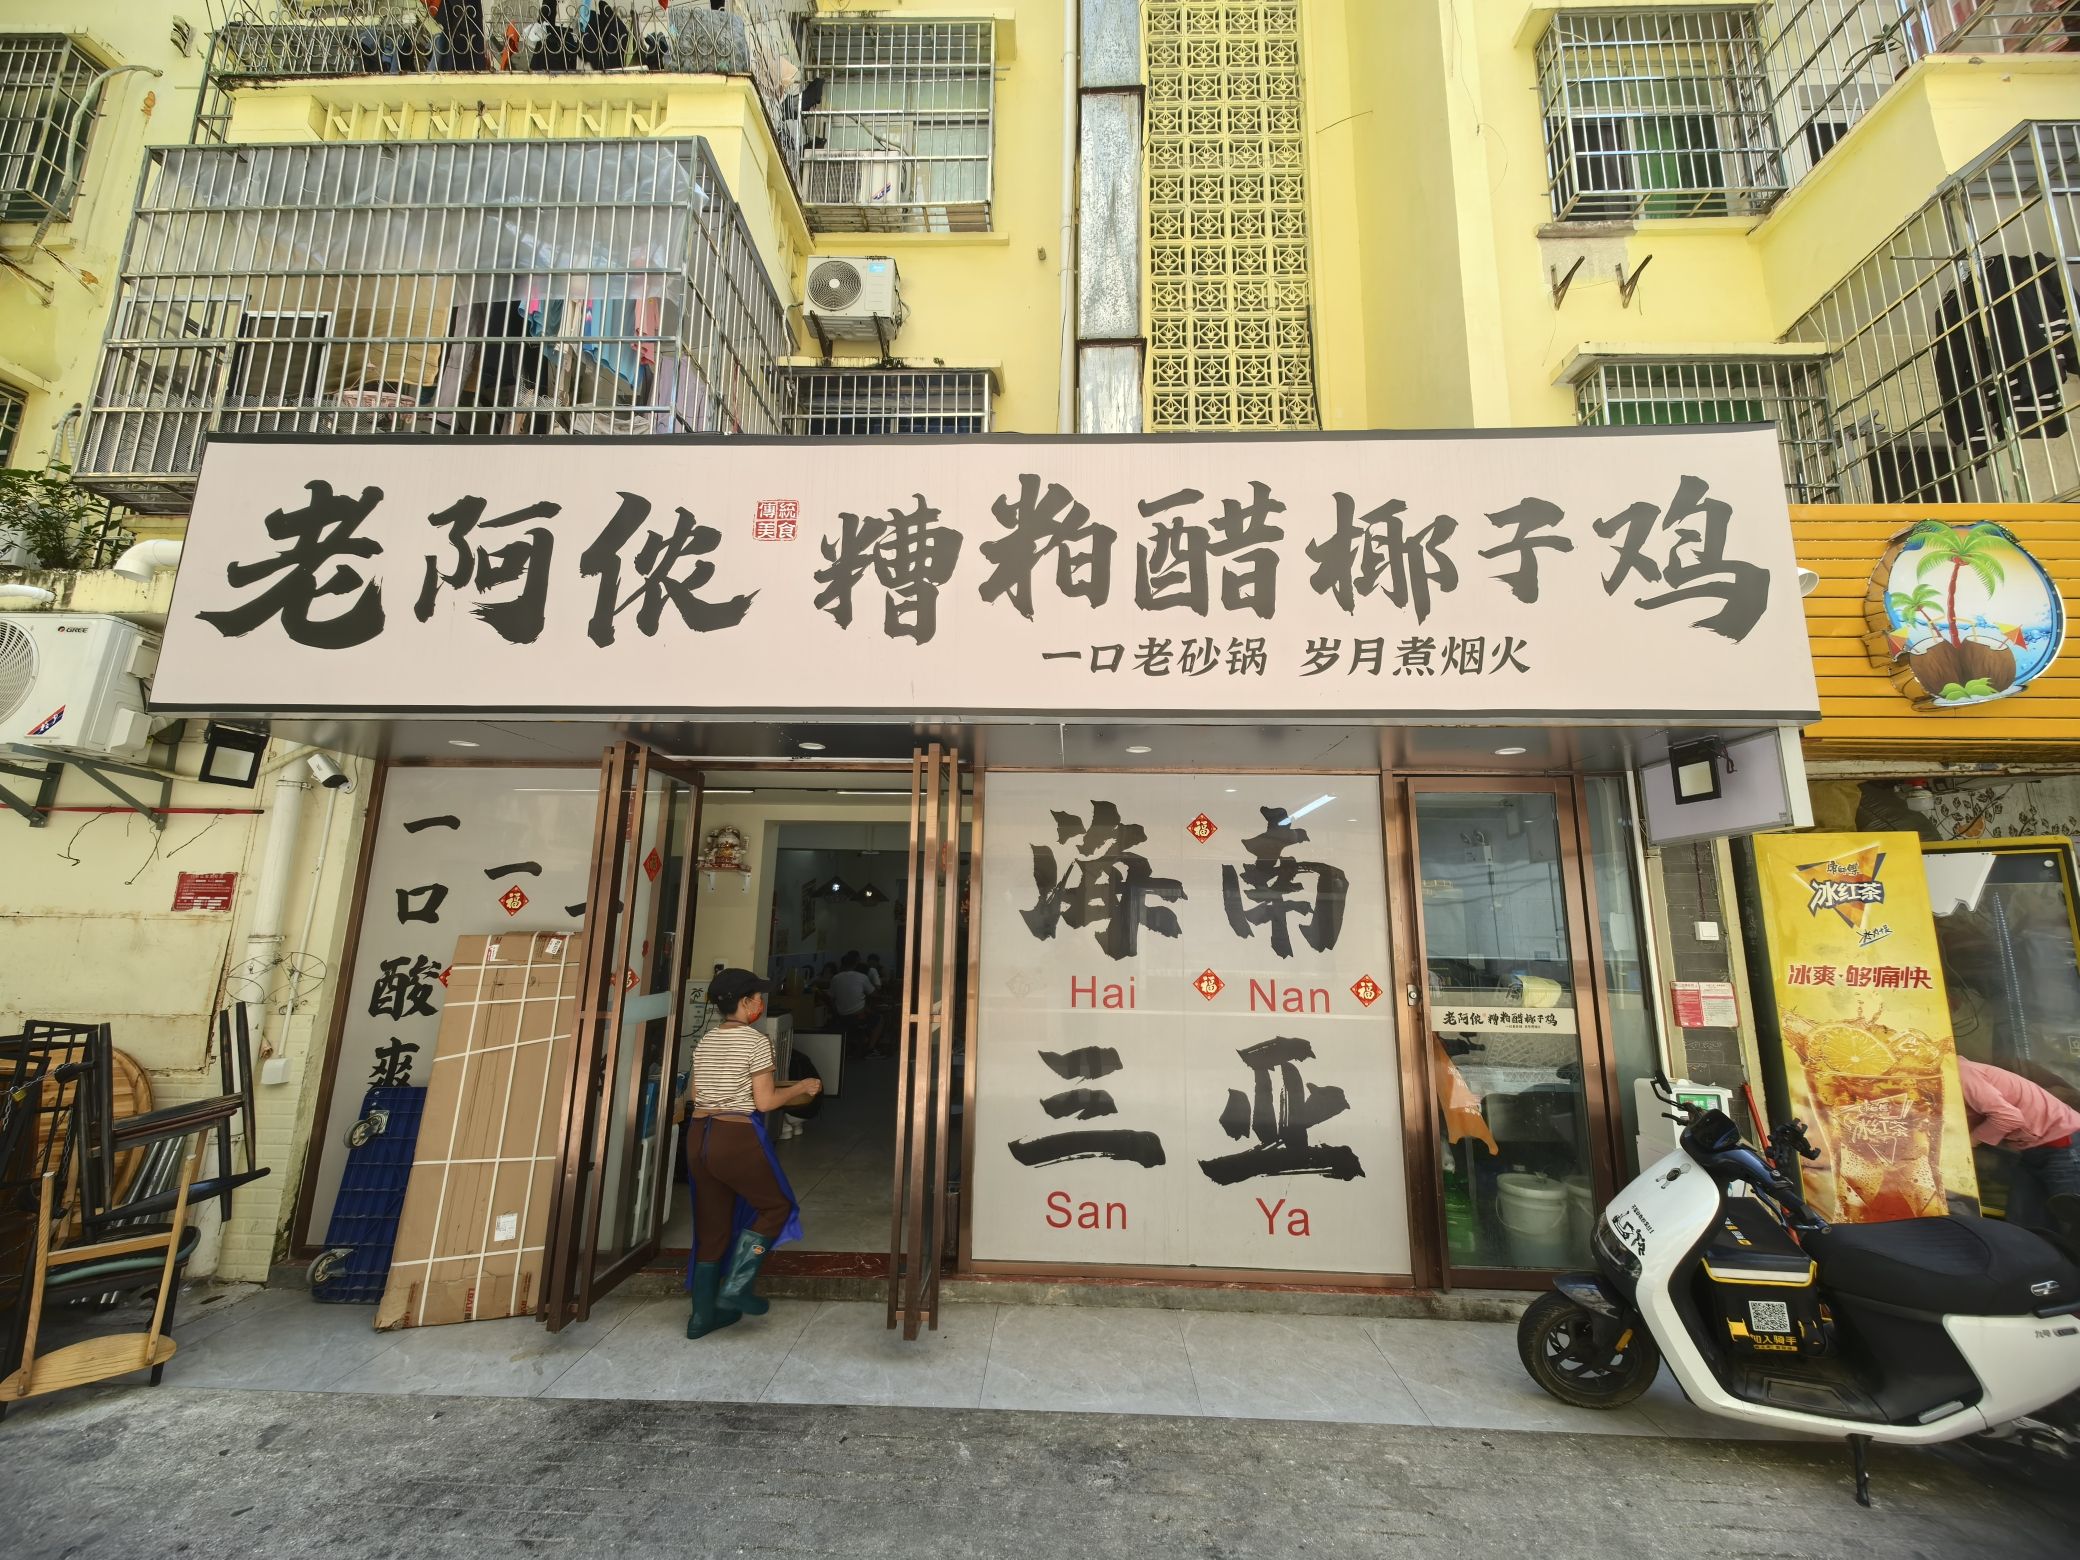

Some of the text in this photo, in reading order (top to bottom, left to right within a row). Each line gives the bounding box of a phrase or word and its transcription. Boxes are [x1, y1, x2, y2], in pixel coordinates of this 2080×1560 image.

[756, 521, 796, 539] 美食
[758, 502, 797, 518] 傳統
[196, 474, 1771, 649] 老阿侬 糟粕醋椰子鸡
[1041, 636, 1531, 677] 一口老砂锅 岁月煮烟火
[1019, 799, 1350, 961] 海南
[1809, 879, 1883, 912] 冰红茶
[1071, 975, 1330, 1013] Hai Nan
[1008, 1036, 1366, 1187] 三亚
[1046, 1191, 1311, 1237] San Ya
